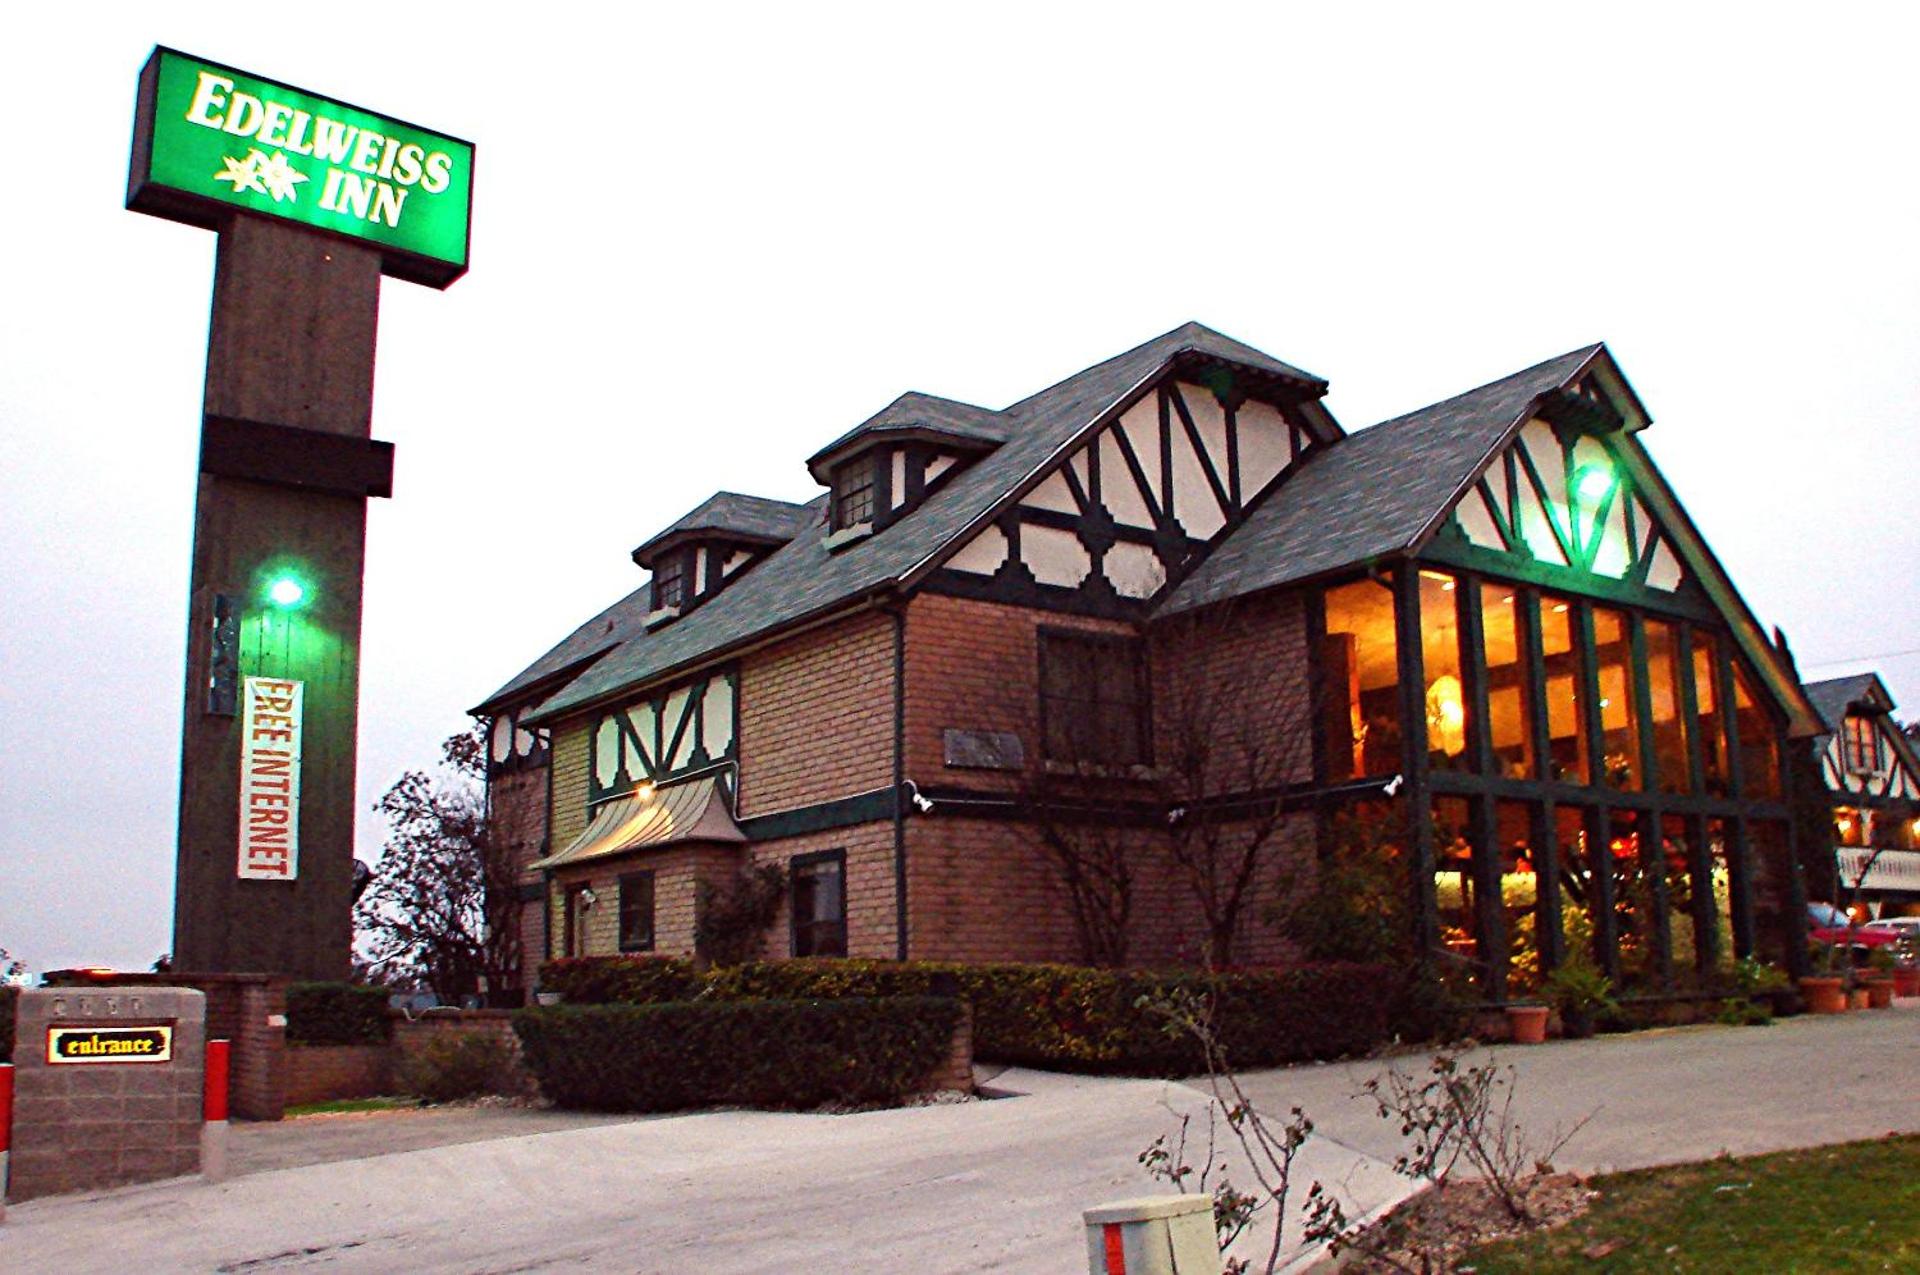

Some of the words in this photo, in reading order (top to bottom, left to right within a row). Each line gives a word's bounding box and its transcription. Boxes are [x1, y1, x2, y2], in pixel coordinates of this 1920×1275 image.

[186, 71, 452, 193] EDELWEISS
[318, 168, 408, 228] INN
[253, 681, 293, 743] FREE
[248, 748, 291, 876] INTERNET
[67, 1034, 154, 1055] entrance
